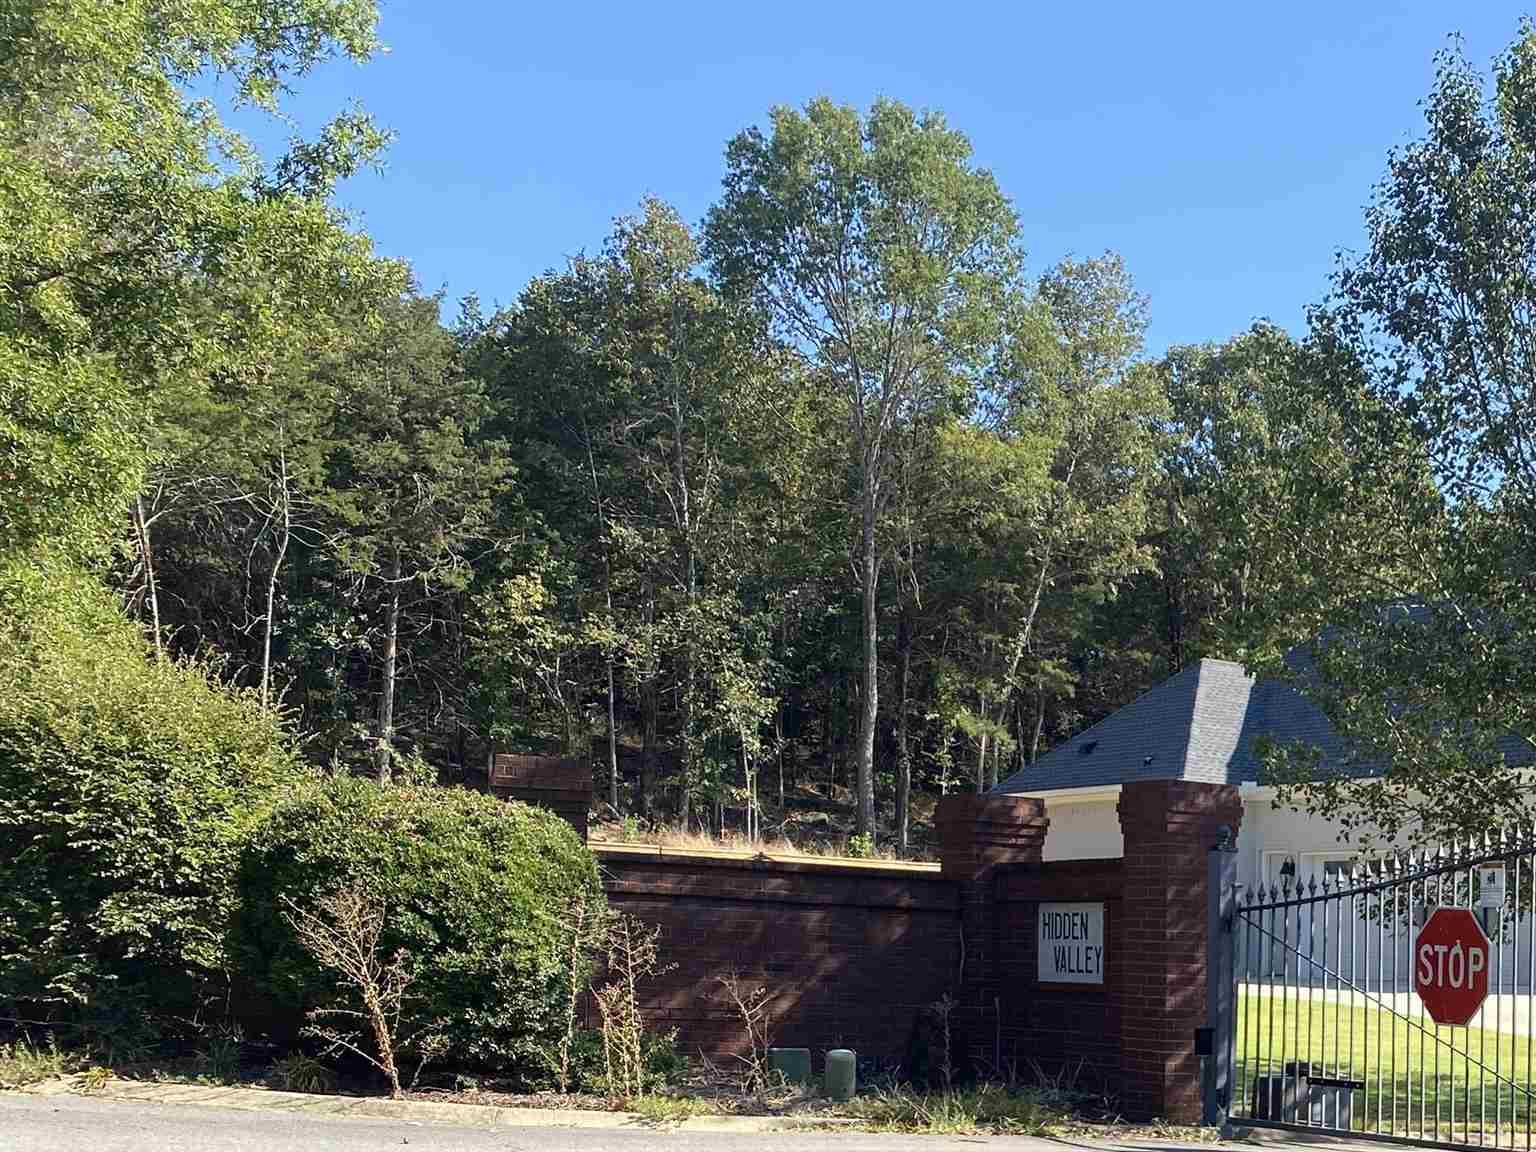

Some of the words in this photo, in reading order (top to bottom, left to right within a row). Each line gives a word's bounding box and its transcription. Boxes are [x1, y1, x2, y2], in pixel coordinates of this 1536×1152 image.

[1042, 911, 1089, 940] HIDDEN
[1054, 945, 1102, 974] VALLEY
[1418, 943, 1484, 990] STOP
